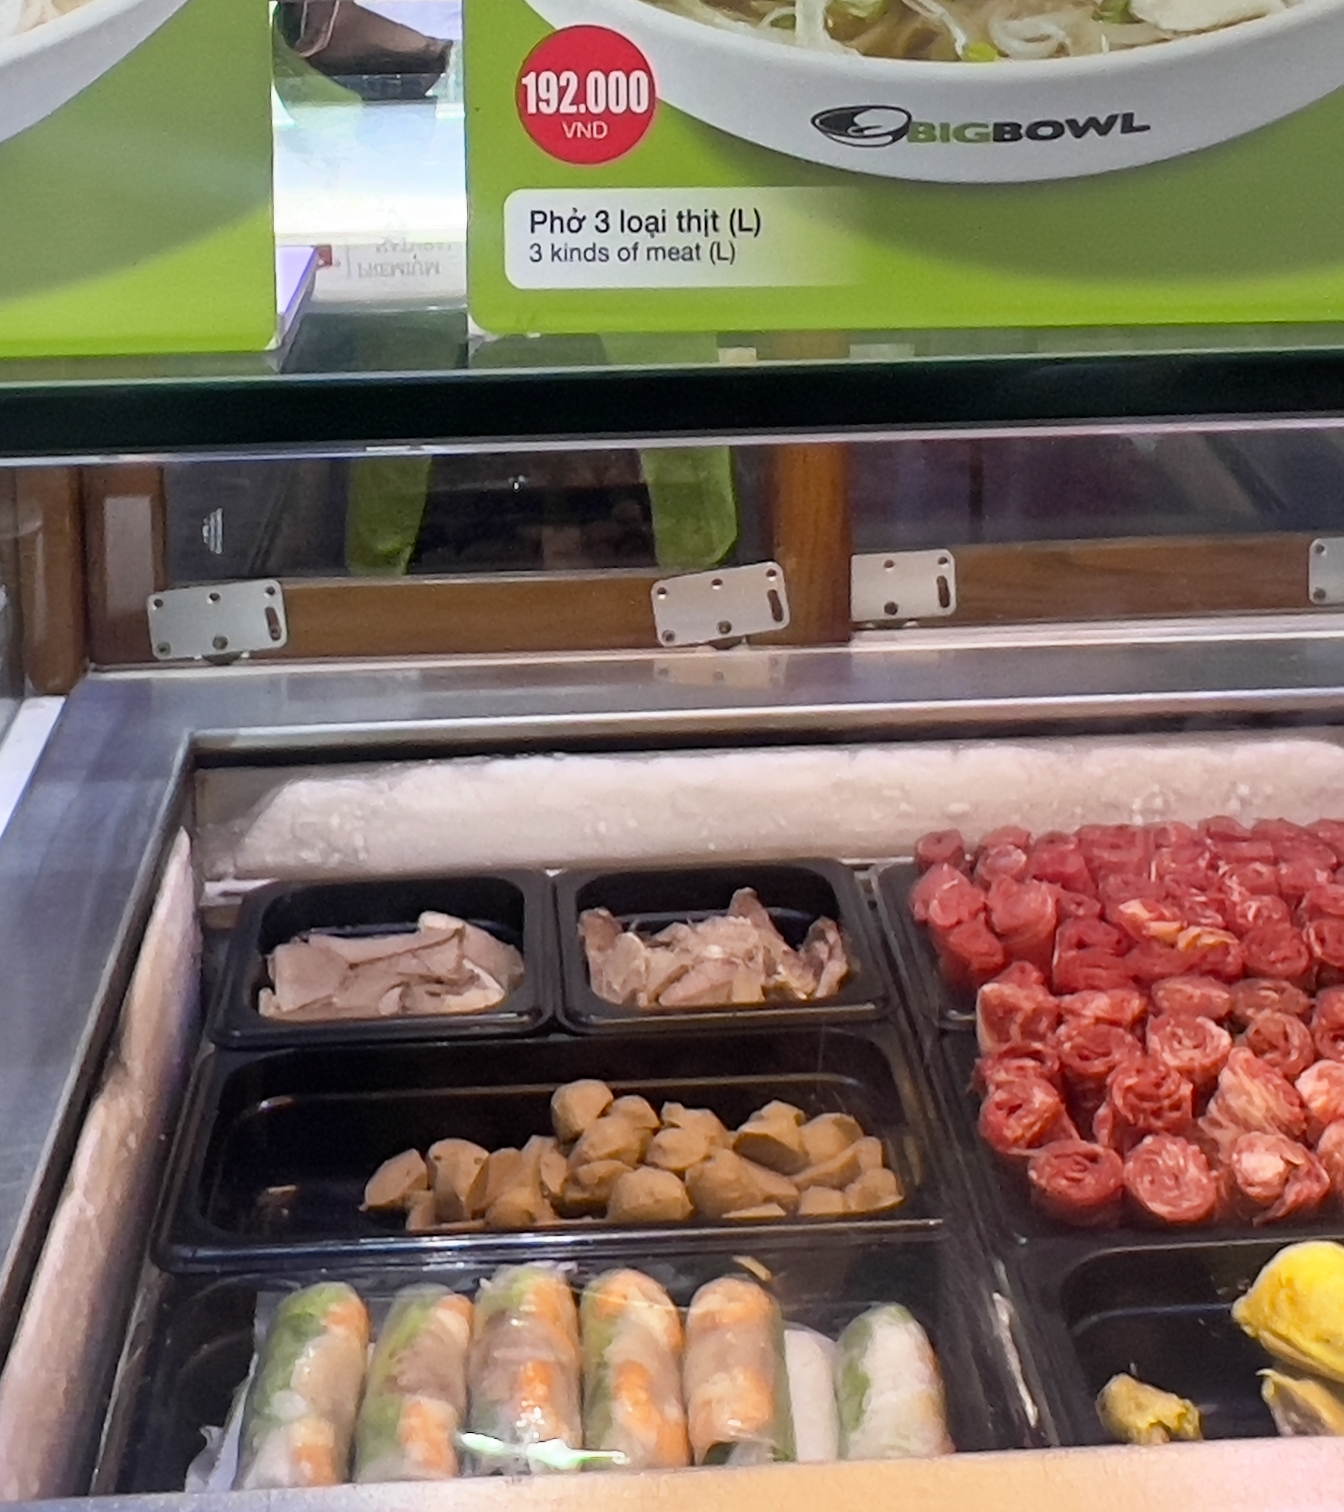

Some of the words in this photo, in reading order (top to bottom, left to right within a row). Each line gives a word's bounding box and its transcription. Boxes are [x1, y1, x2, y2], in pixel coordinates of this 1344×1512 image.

[522, 69, 650, 115] 192.000
[562, 120, 608, 140] VND
[908, 111, 1151, 145] BIGBOWL
[530, 207, 587, 234] Phở
[594, 210, 610, 233] 3
[620, 209, 667, 238] loại
[676, 208, 719, 237] thịt
[729, 208, 761, 237] (L)
[529, 243, 543, 263] 3
[550, 243, 610, 263] kinds
[617, 241, 639, 262] of
[646, 243, 702, 262] meat
[709, 240, 736, 265] (L)
